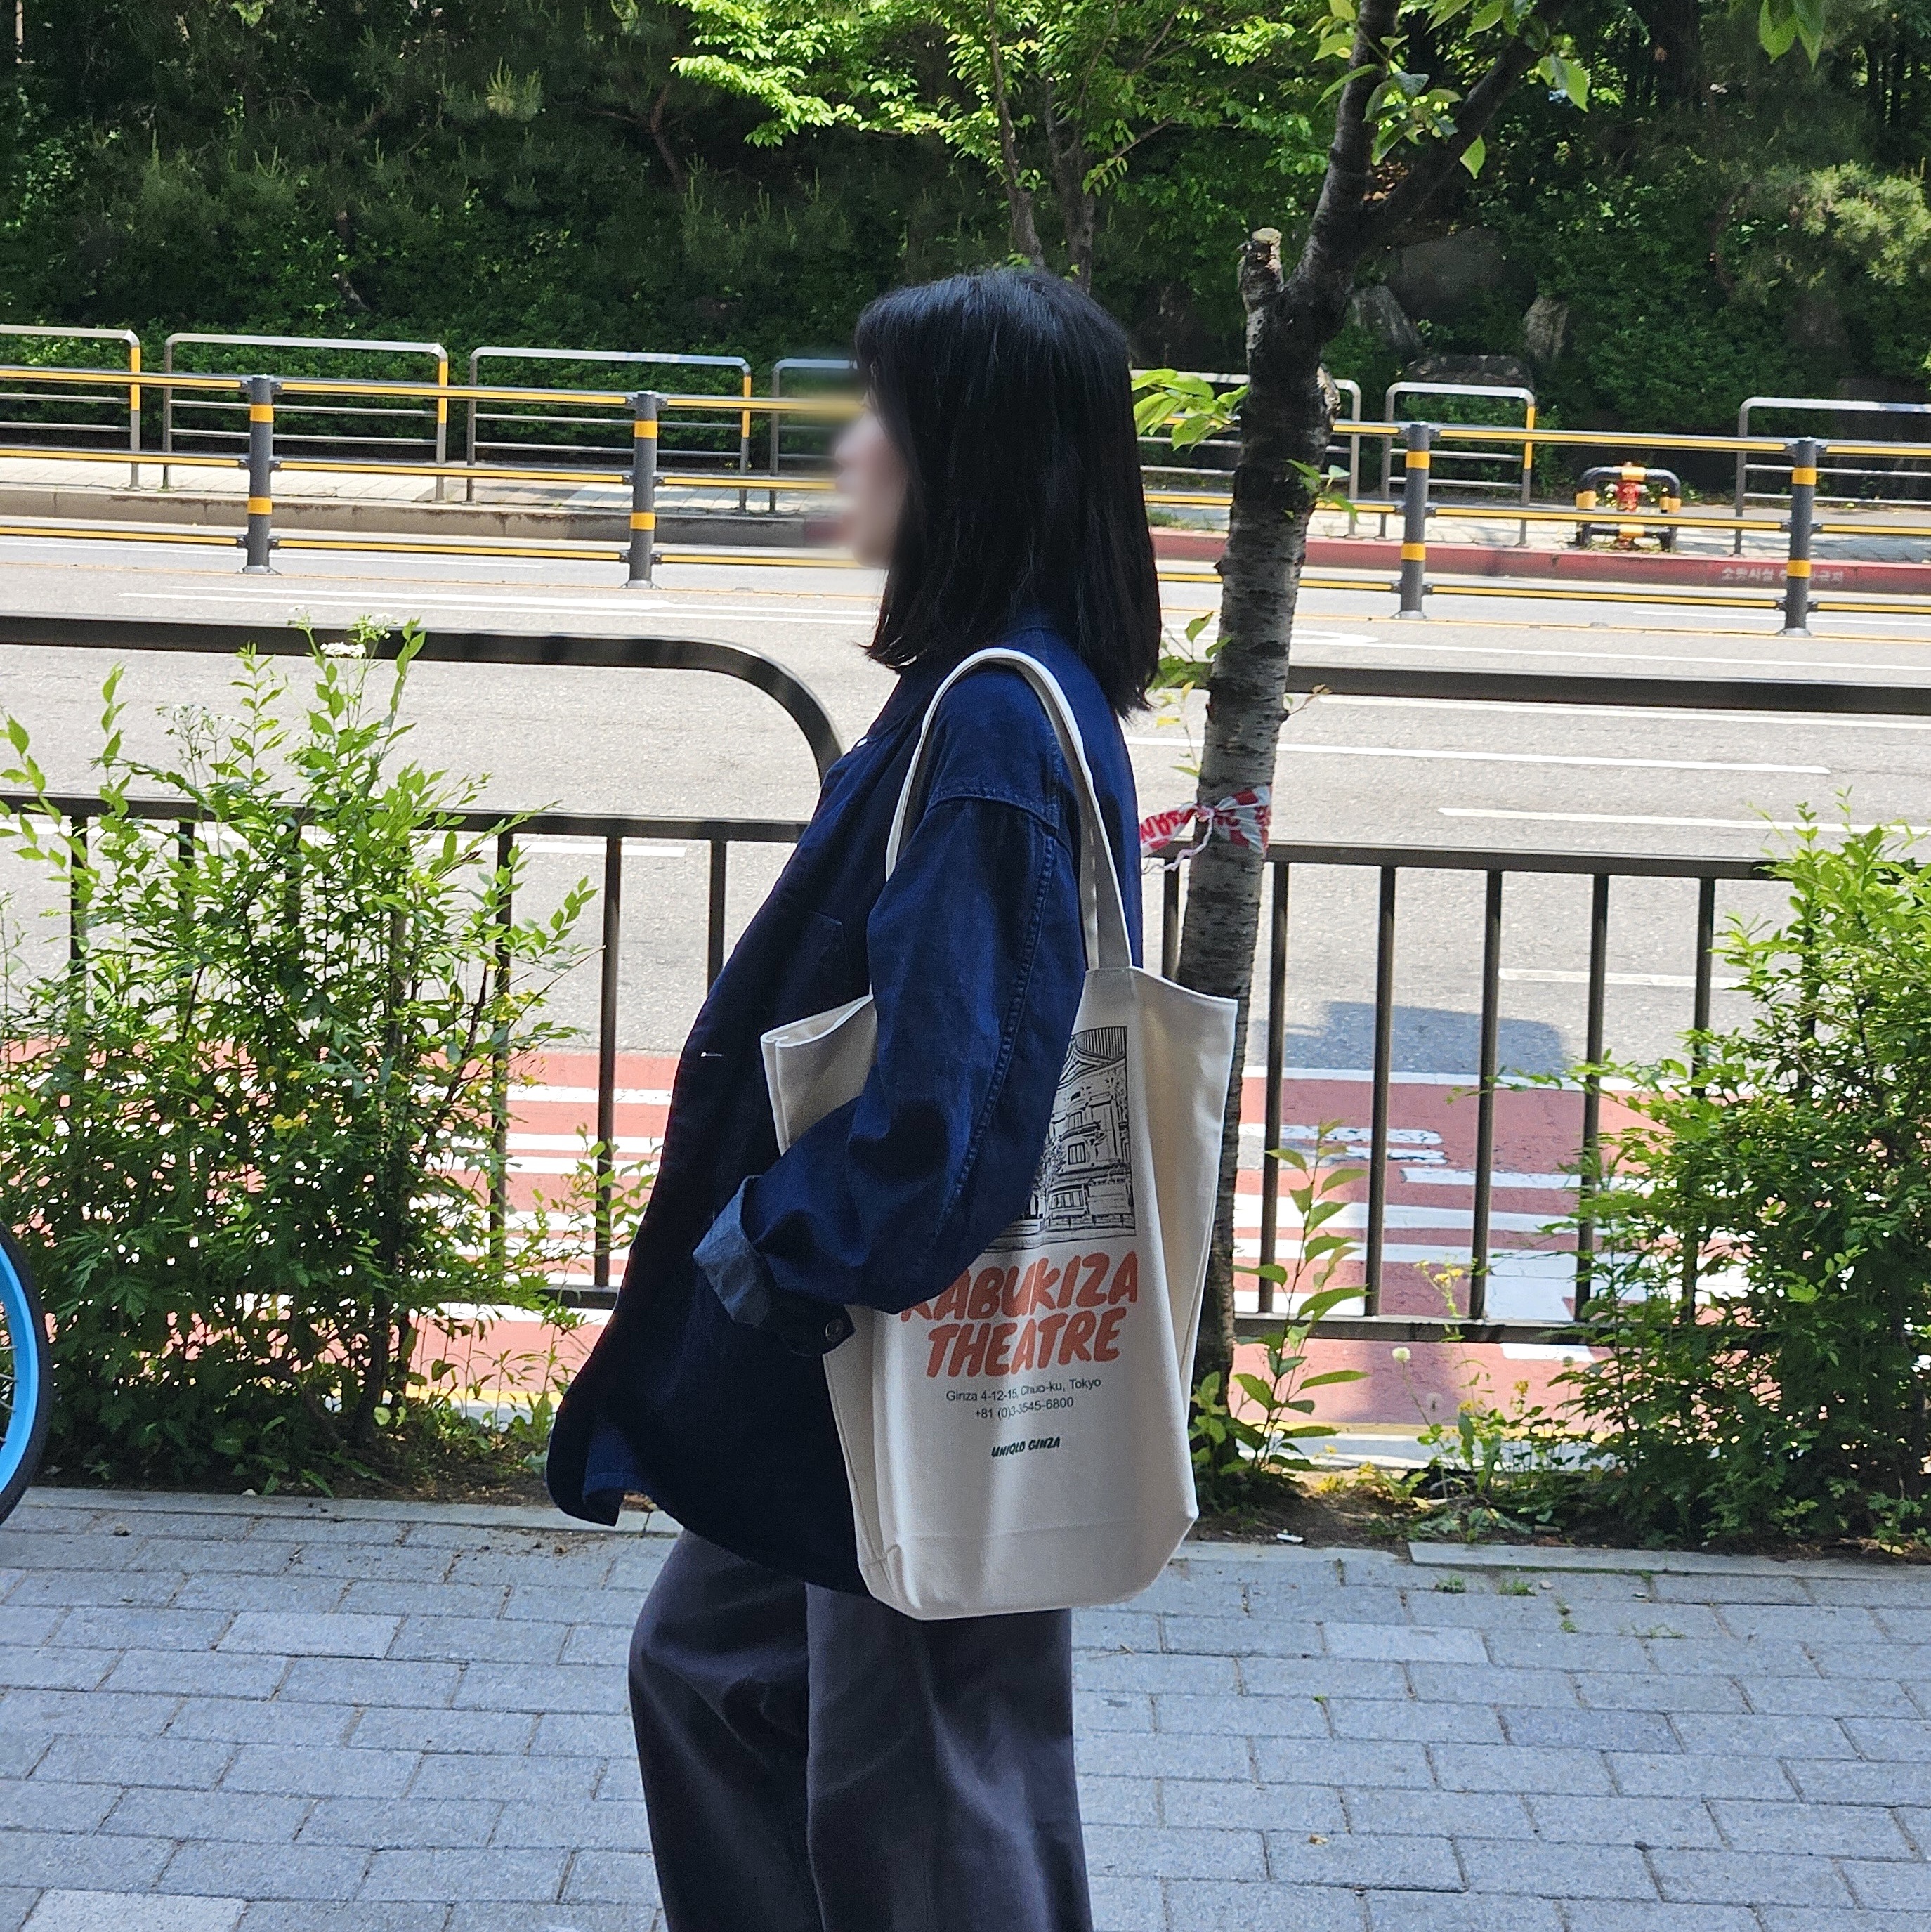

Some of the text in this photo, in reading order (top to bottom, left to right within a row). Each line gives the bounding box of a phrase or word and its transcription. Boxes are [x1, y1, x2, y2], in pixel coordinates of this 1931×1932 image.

[900, 1251, 1139, 1322] ABUKIZA
[926, 1307, 1127, 1378] THEATRE
[946, 1390, 977, 1402] Ginza
[981, 1388, 1019, 1402] 4-12-15,
[1069, 1378, 1101, 1390] Tokyo
[975, 1408, 993, 1419] +81
[991, 1436, 1061, 1458] UNIQLO GINZA
